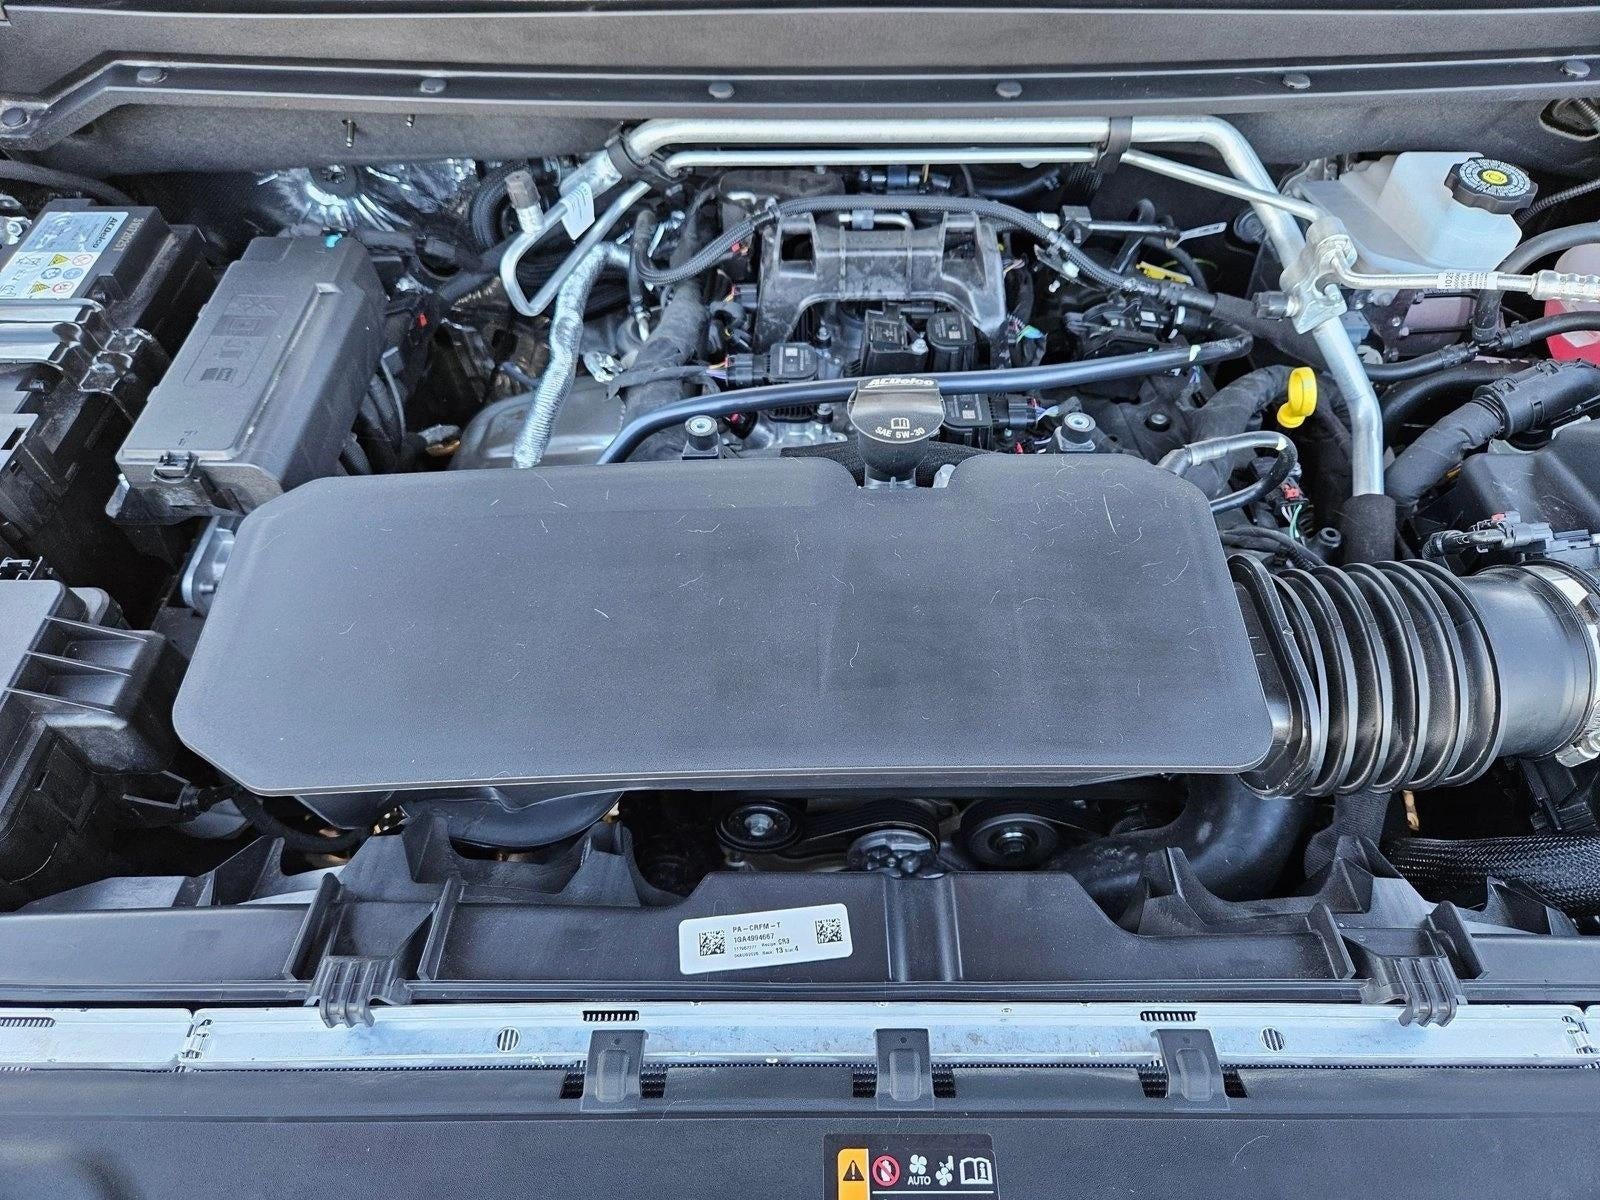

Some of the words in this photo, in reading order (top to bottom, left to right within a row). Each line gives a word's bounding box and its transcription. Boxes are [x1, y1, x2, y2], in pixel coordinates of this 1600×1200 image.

[93, 217, 118, 249] ACDelco
[864, 377, 935, 389] ACDelco
[875, 426, 893, 437] SAE
[895, 427, 926, 439] 5W-30
[775, 946, 784, 954] 13
[907, 1175, 932, 1186] AUTO
